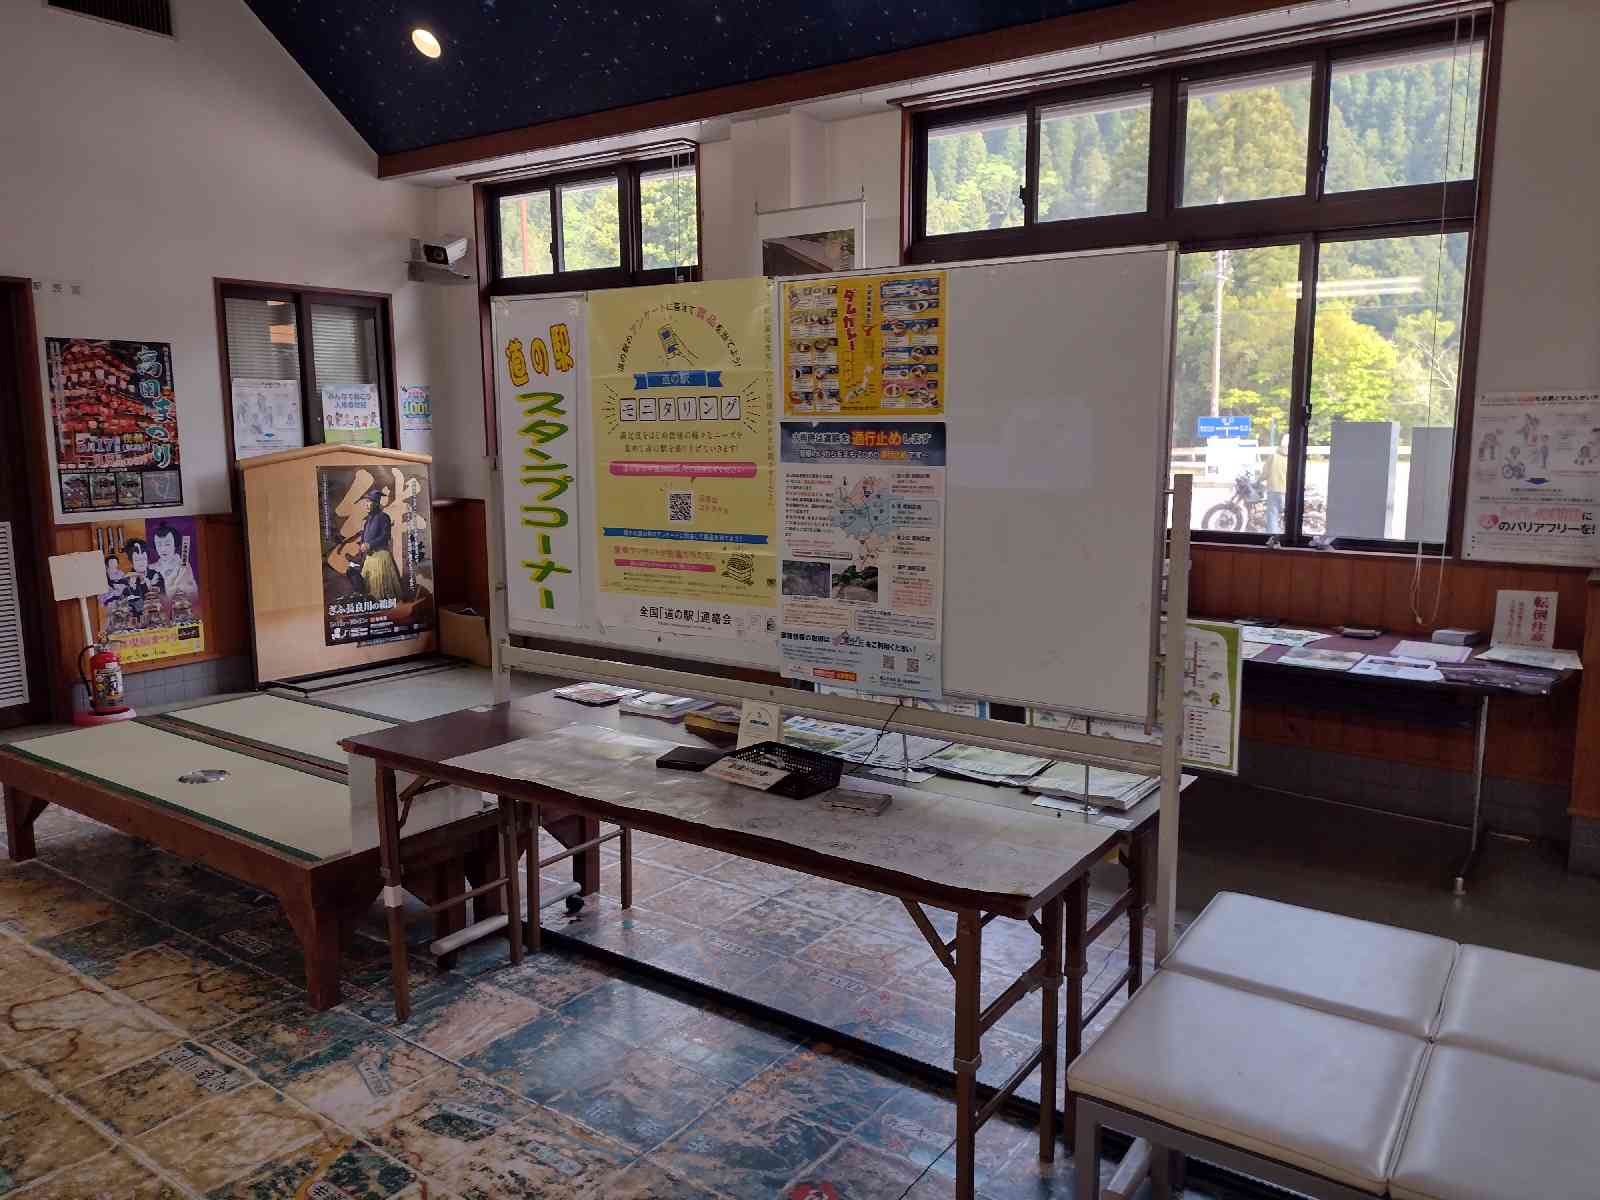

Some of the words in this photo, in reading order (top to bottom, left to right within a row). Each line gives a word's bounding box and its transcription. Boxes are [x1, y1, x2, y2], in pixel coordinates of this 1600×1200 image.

[505, 323, 574, 387] 道の駅
[516, 391, 574, 610] スタンプコーナー
[639, 605, 732, 625] 全国「道の駅」連絡会
